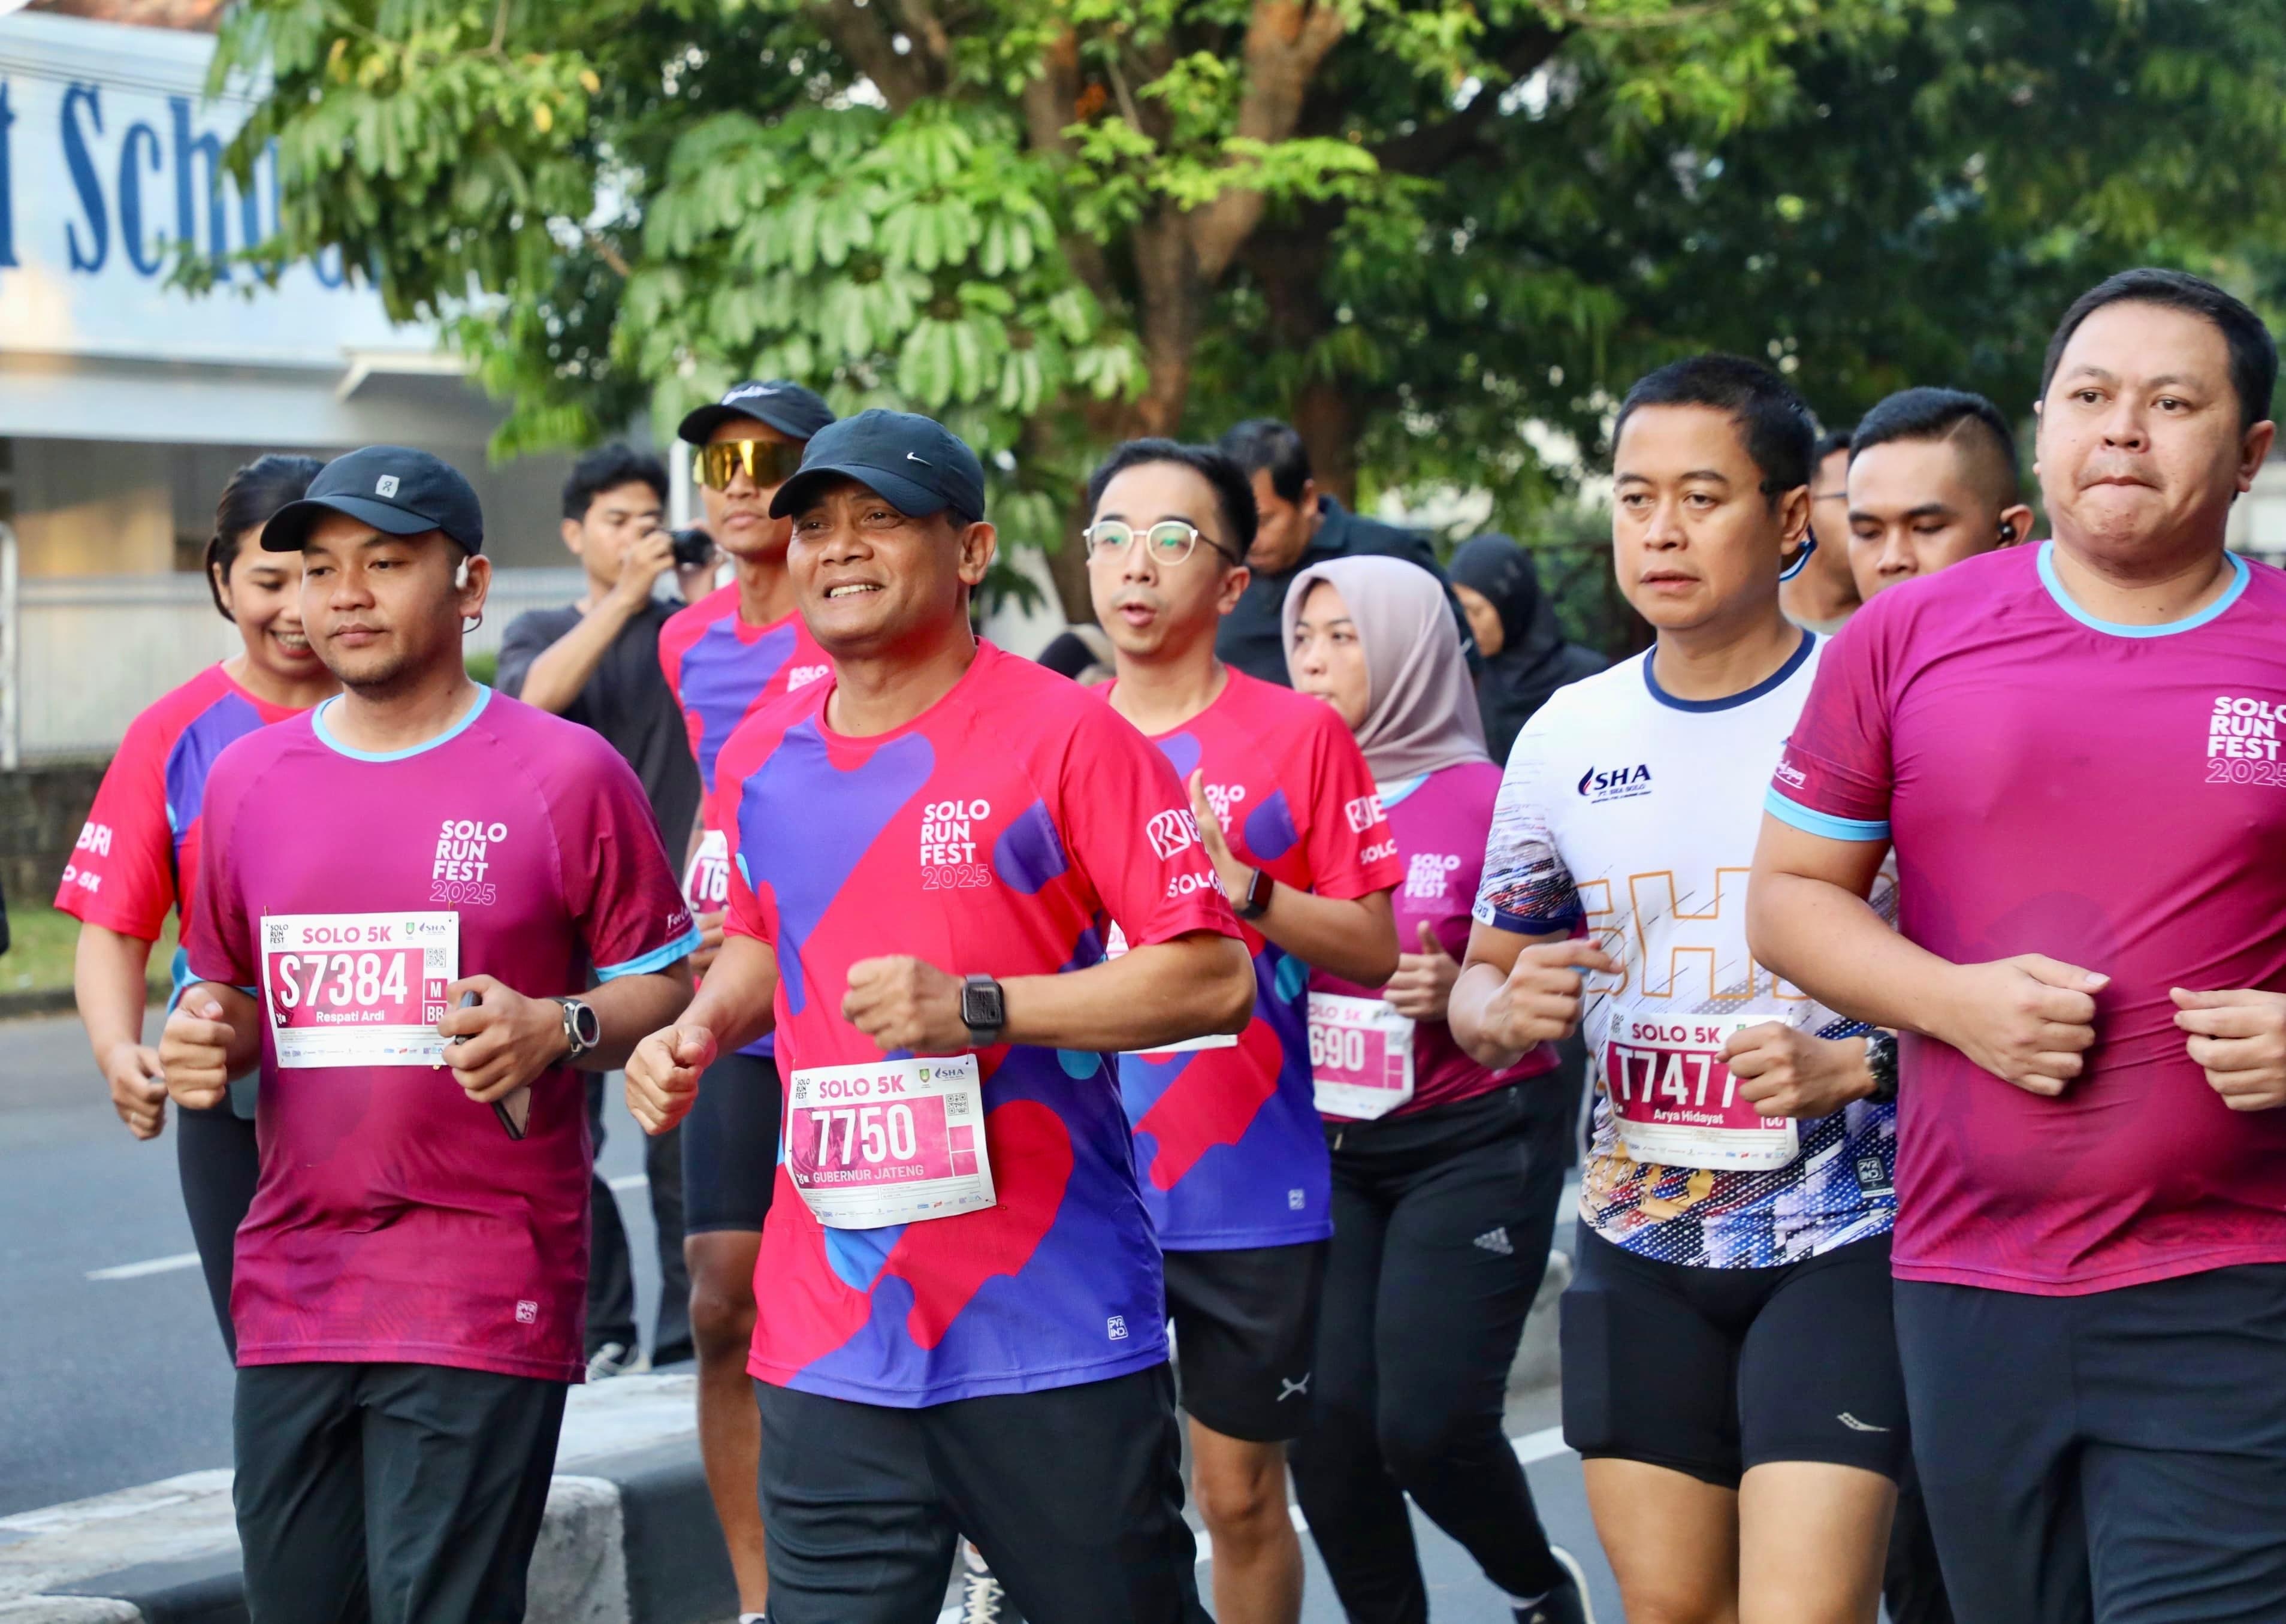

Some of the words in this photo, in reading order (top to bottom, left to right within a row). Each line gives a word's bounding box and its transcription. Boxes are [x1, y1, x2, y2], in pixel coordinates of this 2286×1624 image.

[2209, 715, 2275, 738] RUN
[2207, 736, 2281, 760] FEST
[1594, 764, 1651, 790] SHA
[1203, 784, 1246, 802] OLO
[922, 799, 991, 823] SOLO
[439, 820, 508, 843] SOLO
[920, 820, 970, 844] RUN
[435, 839, 487, 862] RUN
[920, 842, 977, 866] FEST
[1410, 853, 1461, 871] SOLO
[432, 859, 489, 882] FEST
[922, 864, 992, 890] 2025
[1407, 868, 1445, 882] RUN
[429, 880, 496, 905] 2025
[1404, 880, 1448, 898] FEST
[302, 926, 360, 944] SOLO
[367, 925, 392, 943] 5K
[279, 951, 408, 1009] S7384
[430, 981, 442, 998] M
[316, 1010, 359, 1024] Respati
[361, 1009, 385, 1022] Ardi
[1632, 1022, 1687, 1043] SOLO
[1695, 1027, 1722, 1044] 5K
[941, 1068, 964, 1077] SHA
[819, 1078, 870, 1099] SOLO
[877, 1074, 907, 1094] 5K
[1653, 1108, 1680, 1123] Arya
[1681, 1110, 1725, 1125] Hidayat
[811, 1103, 917, 1167] 7750
[813, 1169, 872, 1183] GUBERNUR
[874, 1164, 925, 1181] JATENG
